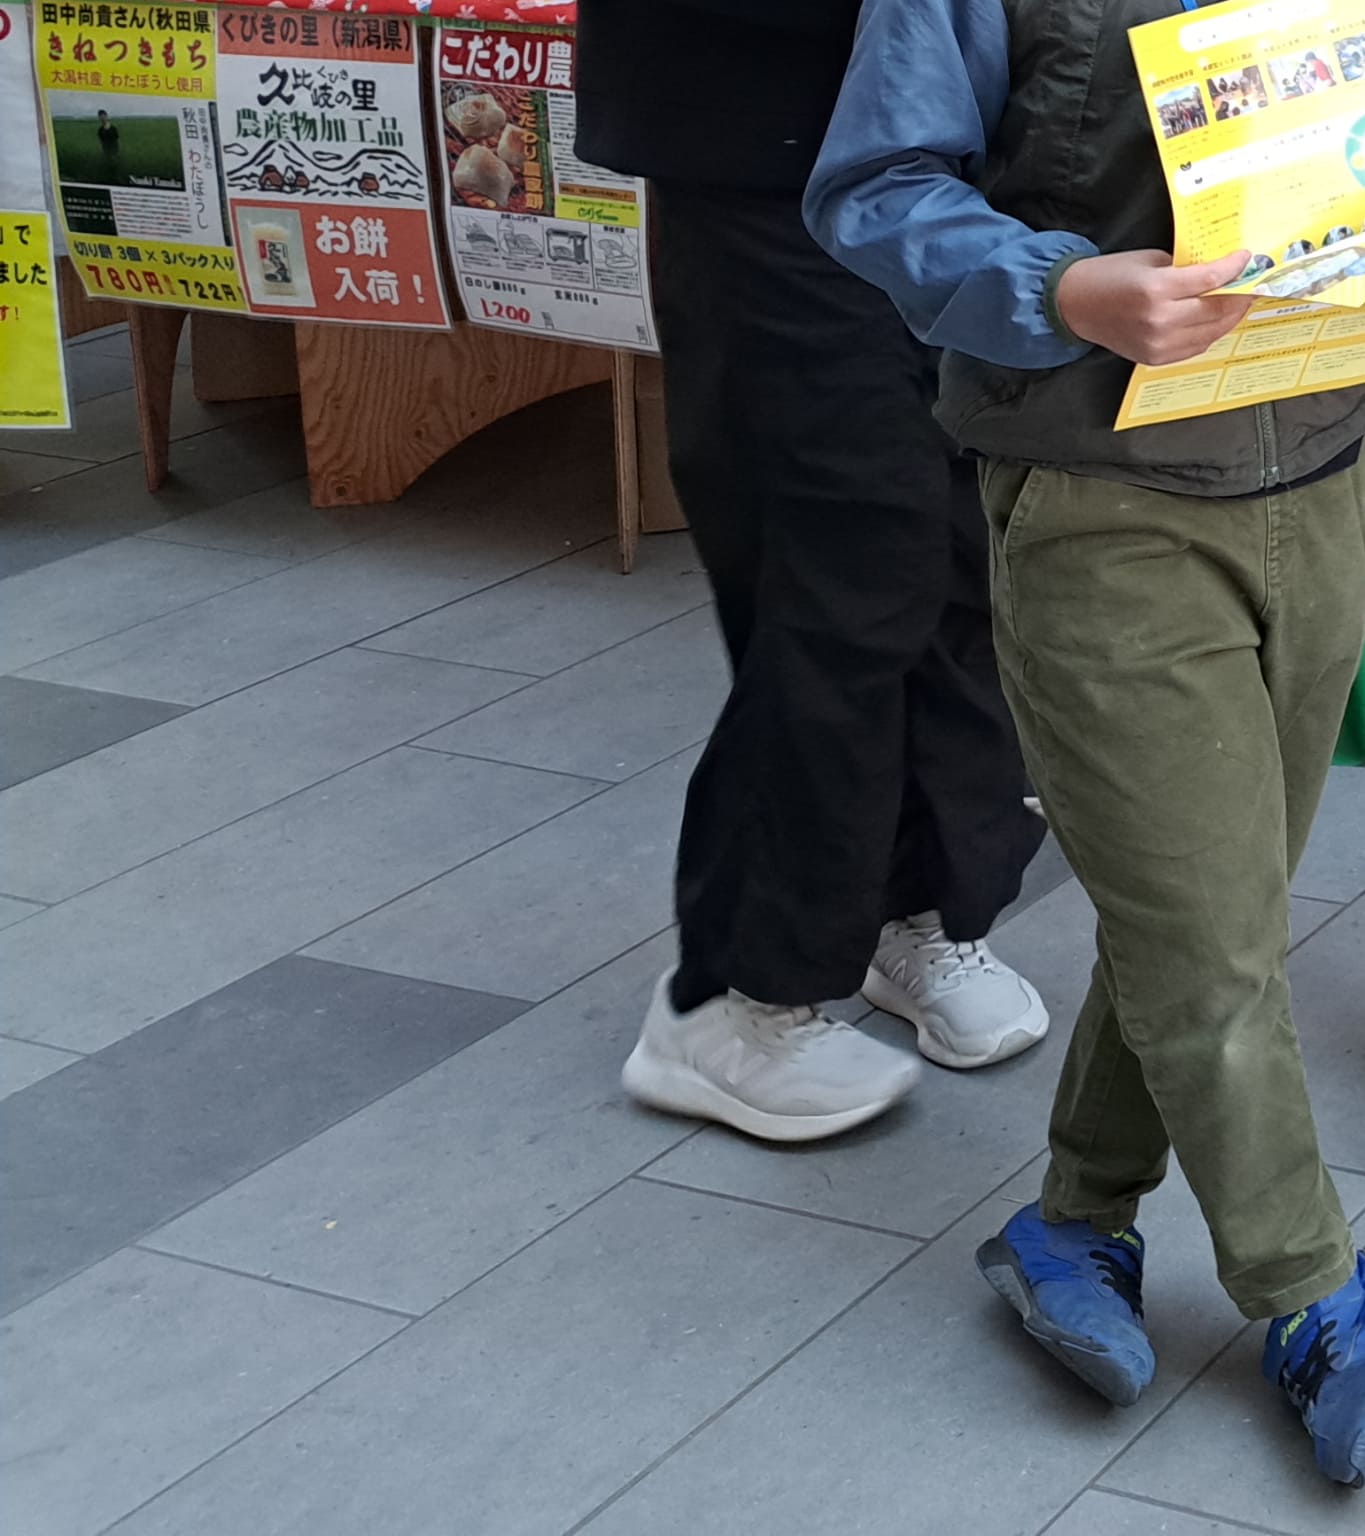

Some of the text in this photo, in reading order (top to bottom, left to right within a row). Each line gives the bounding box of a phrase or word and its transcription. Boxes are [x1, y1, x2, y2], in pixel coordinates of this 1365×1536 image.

[48, 31, 207, 71] きねつきもち
[442, 35, 573, 89] こだわり農
[110, 73, 203, 93] わたぼうし使用
[257, 61, 380, 112] 久比岐の里
[182, 107, 199, 140] 秋田
[235, 108, 405, 147] 農産物加工品
[315, 215, 390, 259] お餅
[162, 250, 235, 271] 3パック入り
[86, 263, 164, 296] 780円
[178, 278, 237, 302] 722円
[334, 267, 426, 306] 入荷！
[480, 298, 531, 324] 1200
